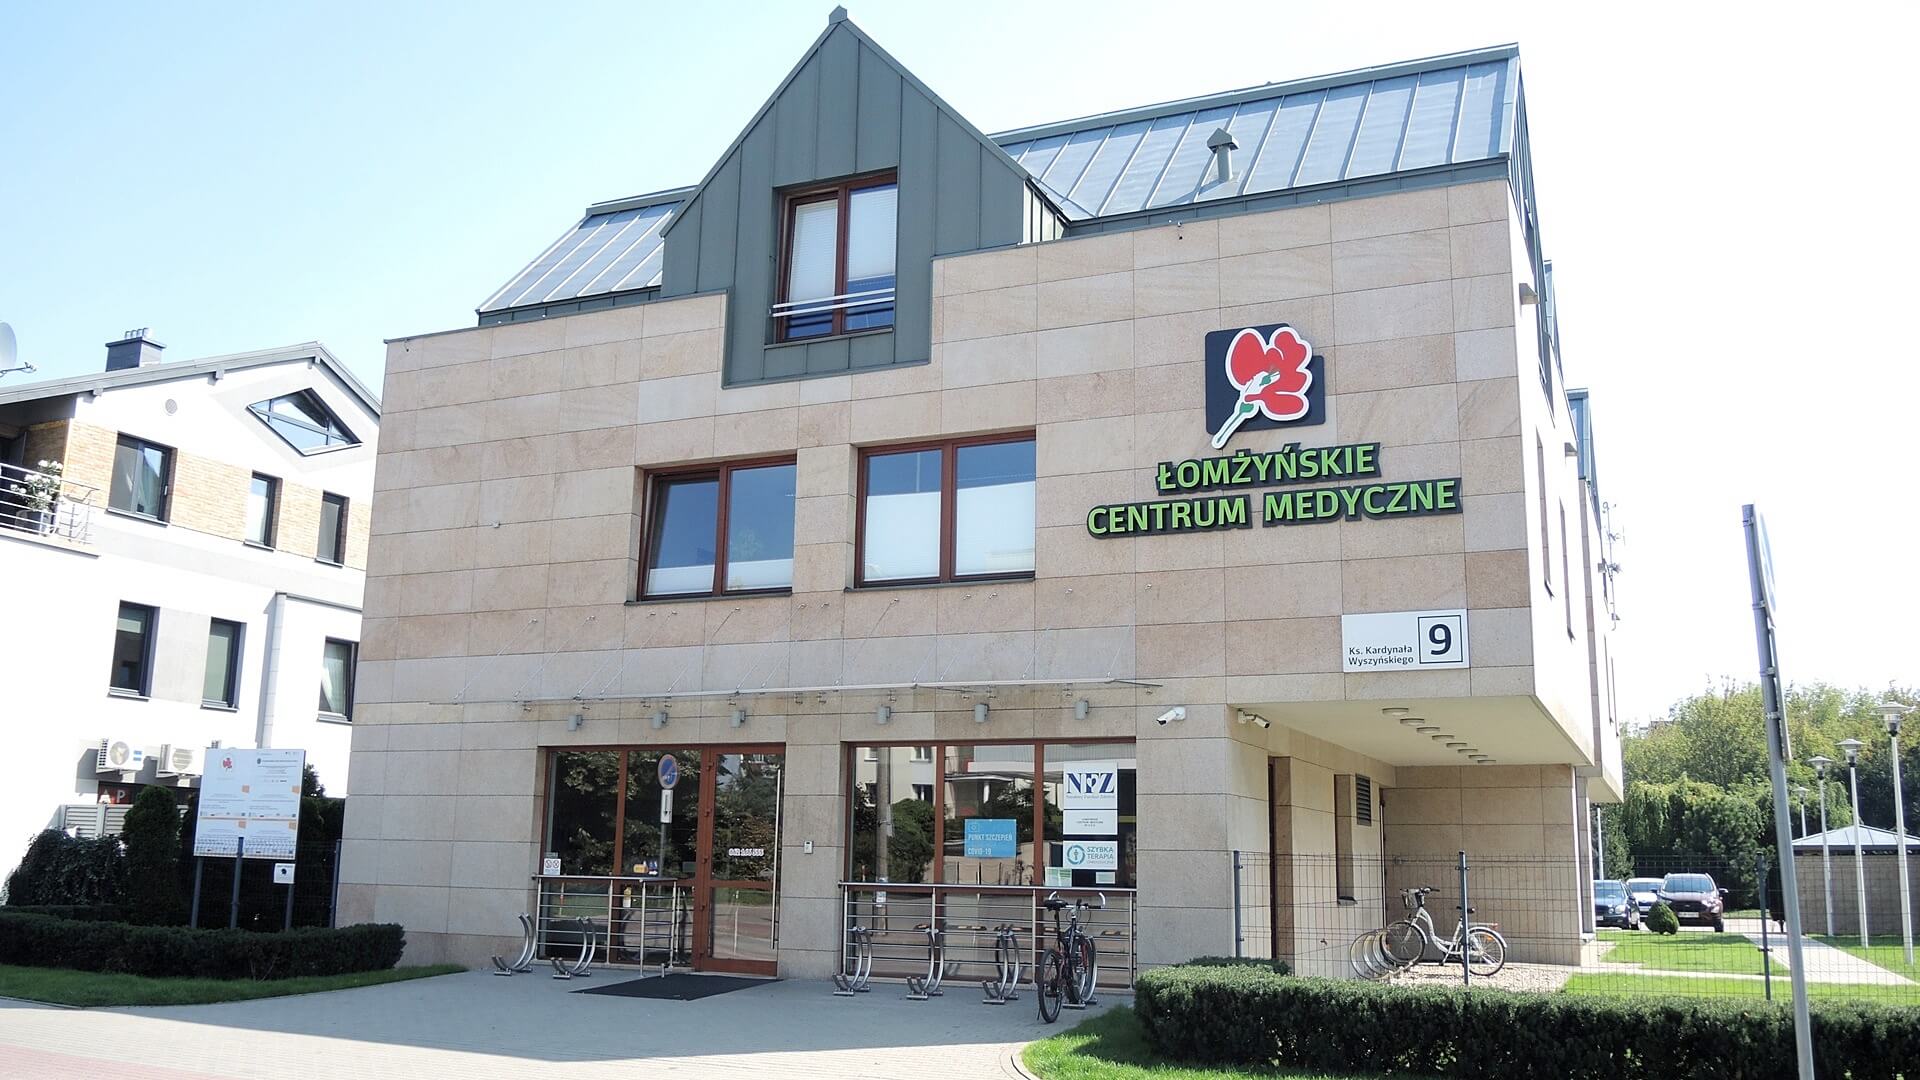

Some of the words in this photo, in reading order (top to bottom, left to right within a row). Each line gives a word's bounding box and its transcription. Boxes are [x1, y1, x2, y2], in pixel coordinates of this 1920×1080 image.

[1157, 445, 1376, 490] ŁOMŻYŃSKIE
[1086, 496, 1247, 535] CENTRUM
[1264, 480, 1457, 522] MEDYCZNE
[1349, 647, 1363, 655] Ks.
[1365, 645, 1413, 656] Kardynała
[1428, 623, 1452, 656] 9
[1348, 656, 1414, 666] Wyszyńskiego
[1066, 772, 1115, 794] NFZ
